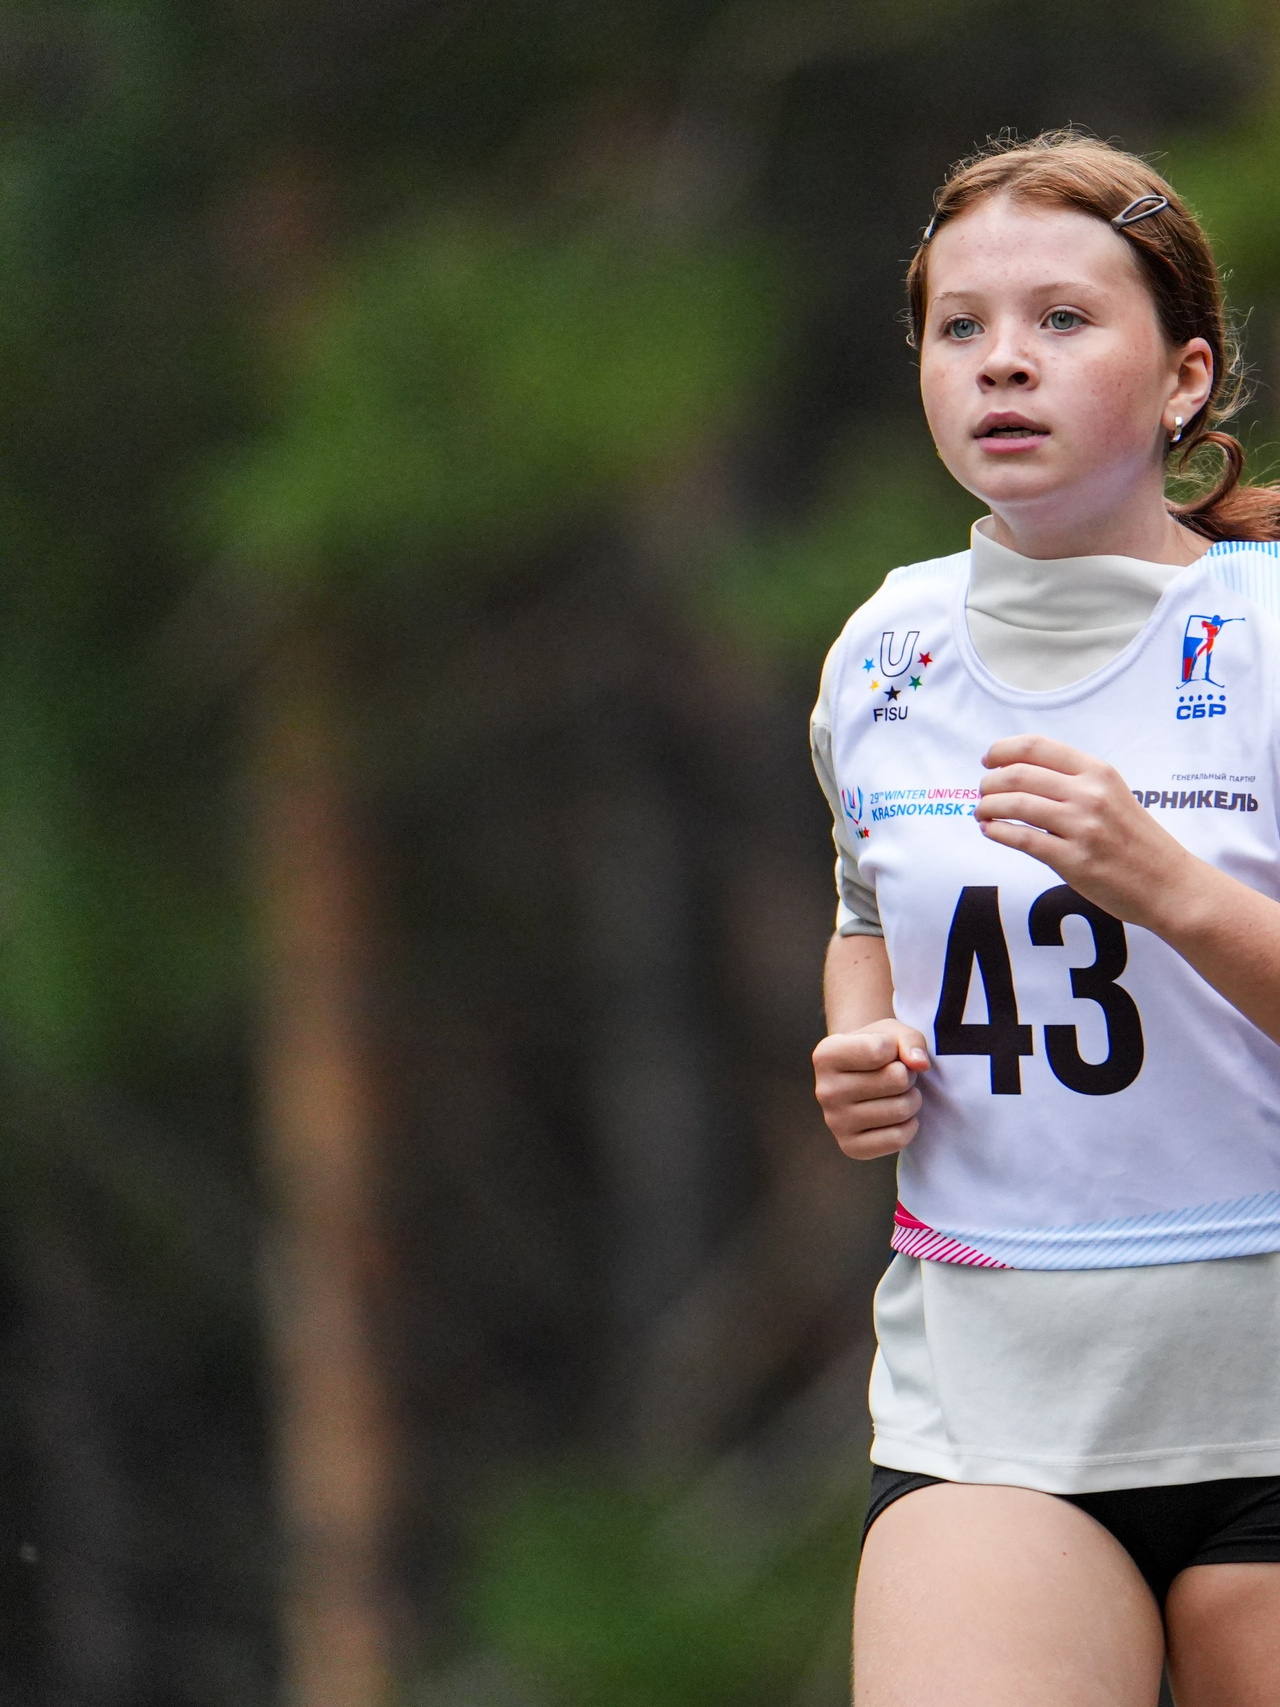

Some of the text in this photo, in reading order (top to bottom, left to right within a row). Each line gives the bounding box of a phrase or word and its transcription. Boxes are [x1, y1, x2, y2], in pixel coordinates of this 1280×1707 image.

[879, 631, 920, 677] U
[873, 706, 909, 722] FISU
[1176, 703, 1227, 720] СБР
[1172, 773, 1227, 781] ГЕНЕРАЛЬНЫЙ
[884, 789, 927, 800] WINTER
[871, 803, 965, 821] KRASNOYARSK
[933, 883, 1145, 1096] 43
